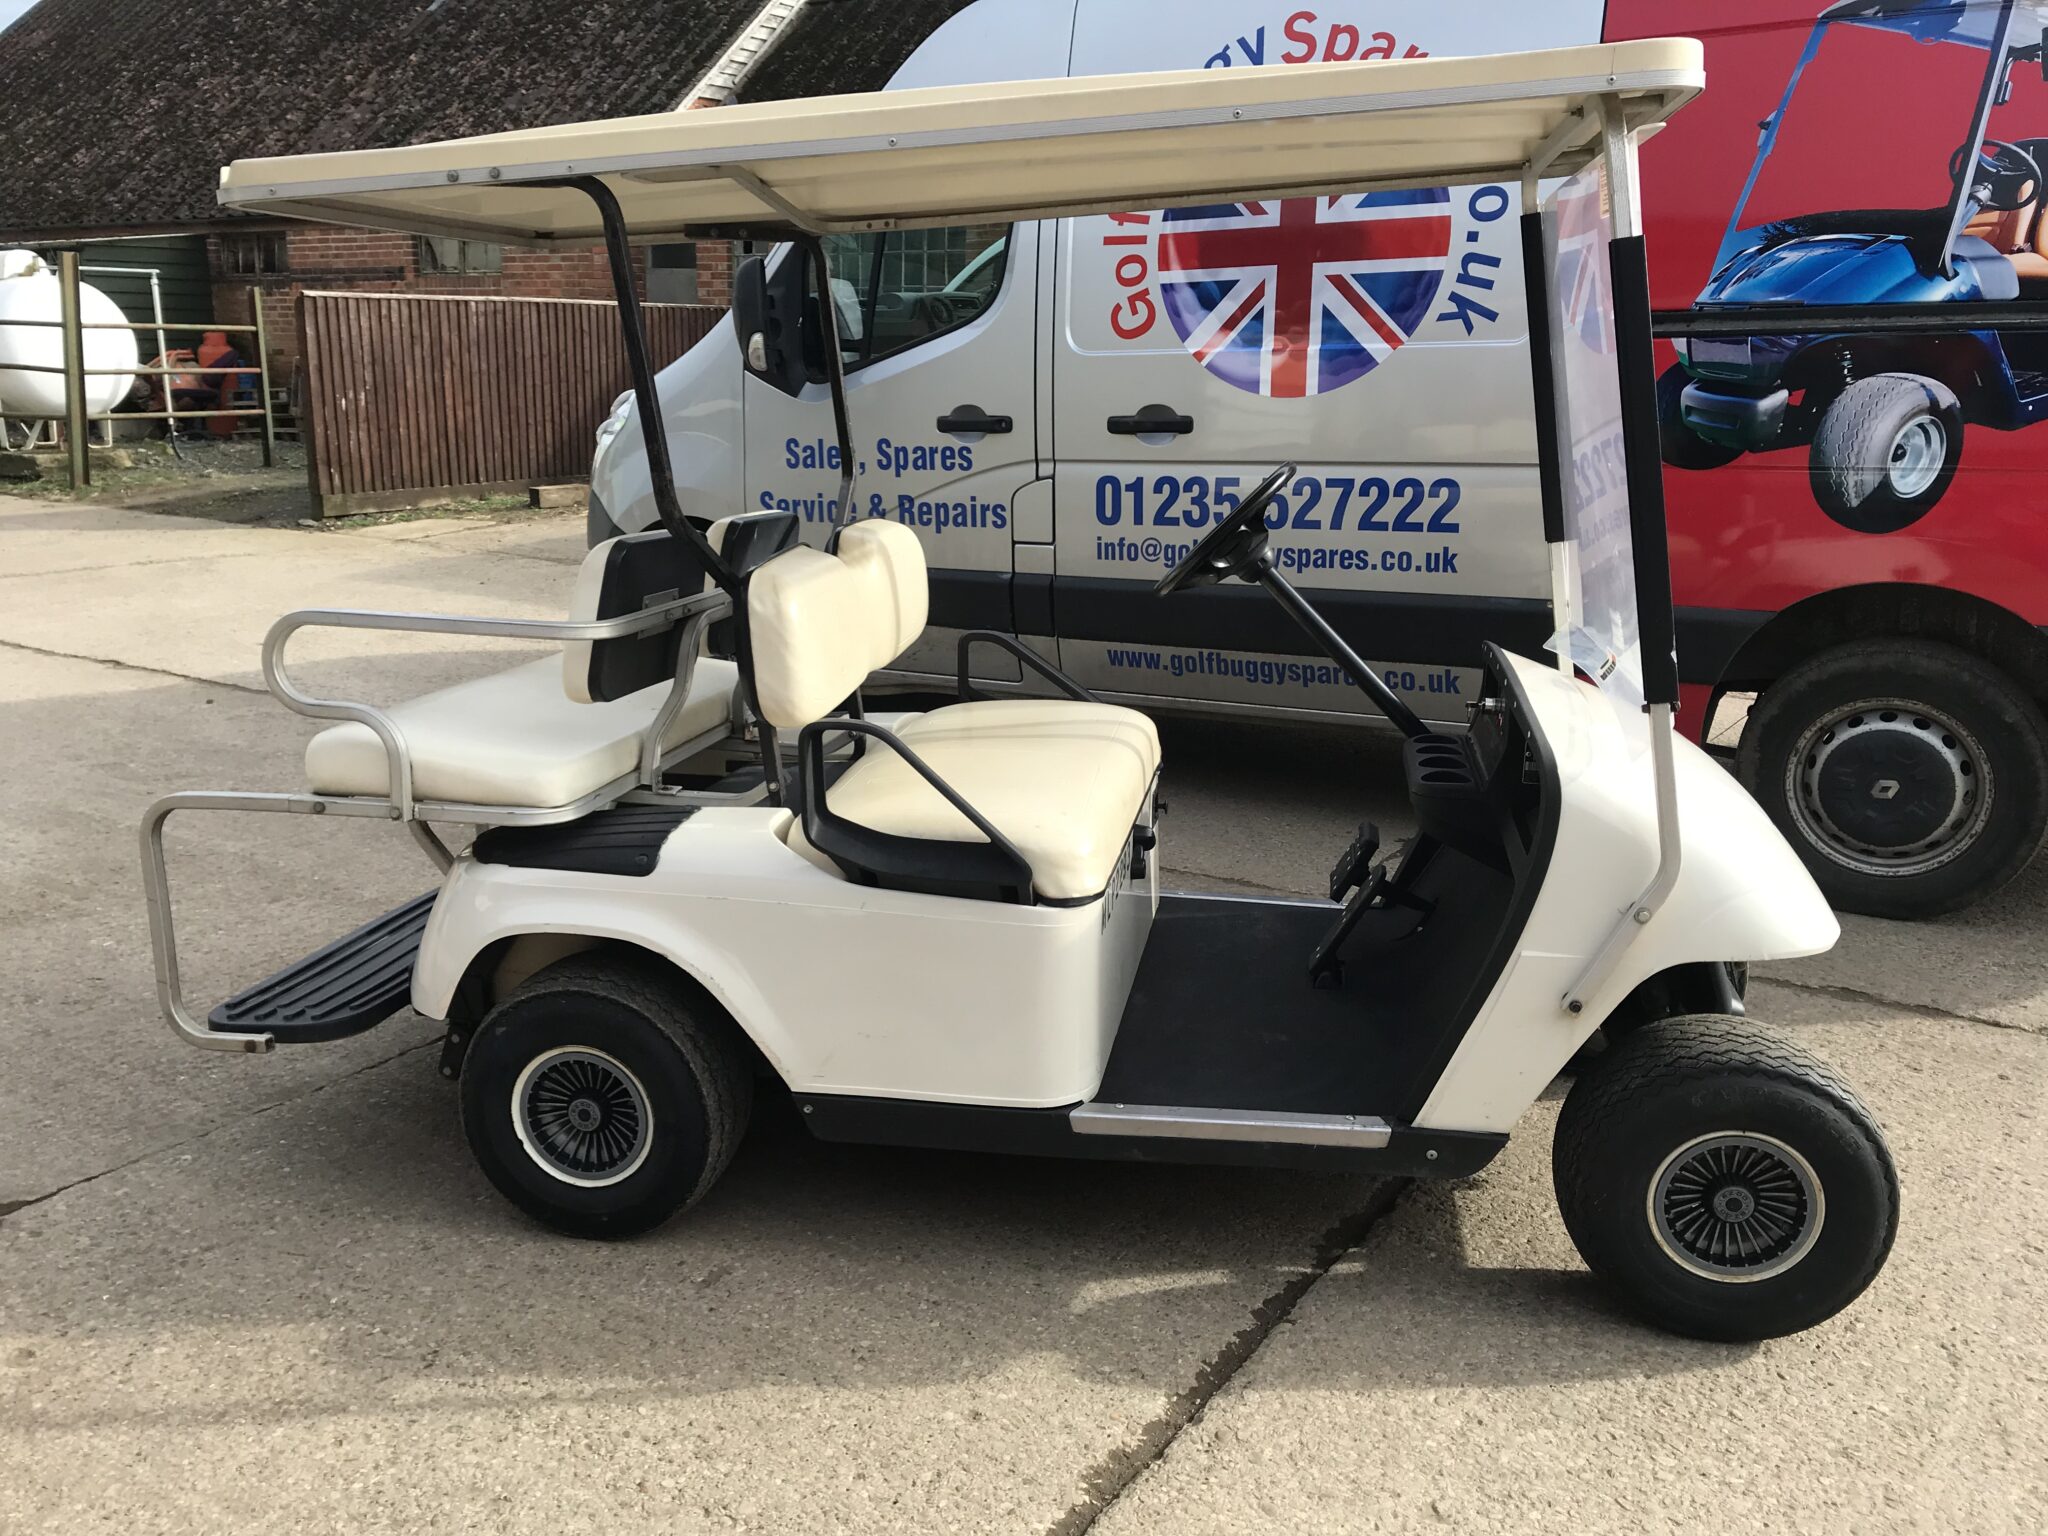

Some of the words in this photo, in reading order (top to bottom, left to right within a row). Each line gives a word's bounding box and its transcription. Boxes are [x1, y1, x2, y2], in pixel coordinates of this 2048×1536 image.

[785, 437, 866, 475] Sale,
[876, 437, 974, 478] Spares
[868, 493, 887, 519] &
[897, 494, 1007, 534] Repairs
[1095, 475, 1241, 528] 01235
[1096, 536, 1458, 574] info@goyspares.co.uk
[1106, 649, 1461, 695] www.golfbuggysparco.uk
